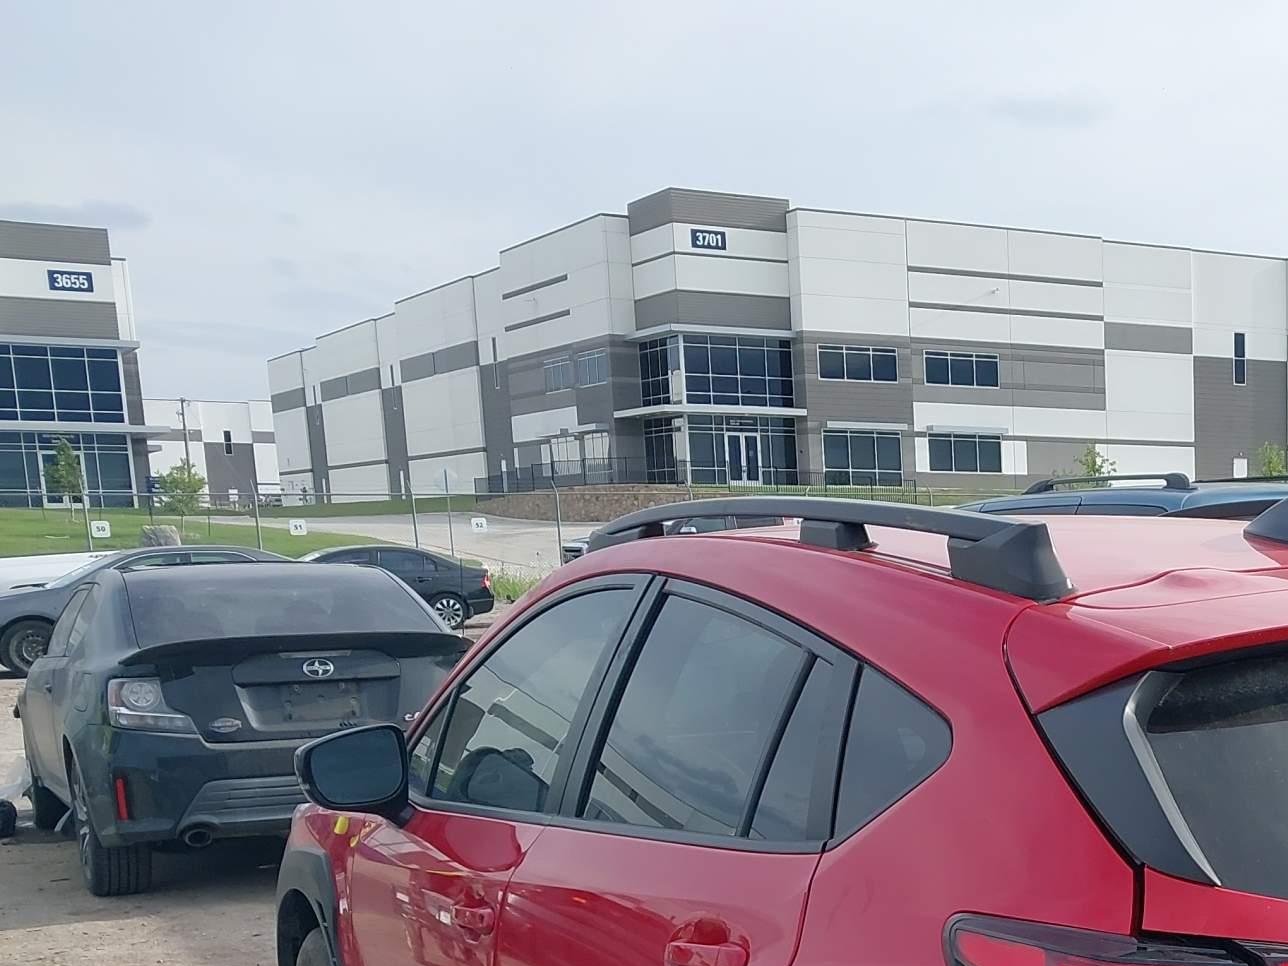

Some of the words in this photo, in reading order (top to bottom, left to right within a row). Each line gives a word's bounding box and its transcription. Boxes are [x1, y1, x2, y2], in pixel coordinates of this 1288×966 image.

[695, 232, 722, 247] 3701
[53, 273, 89, 289] 3655
[95, 525, 106, 533] 50
